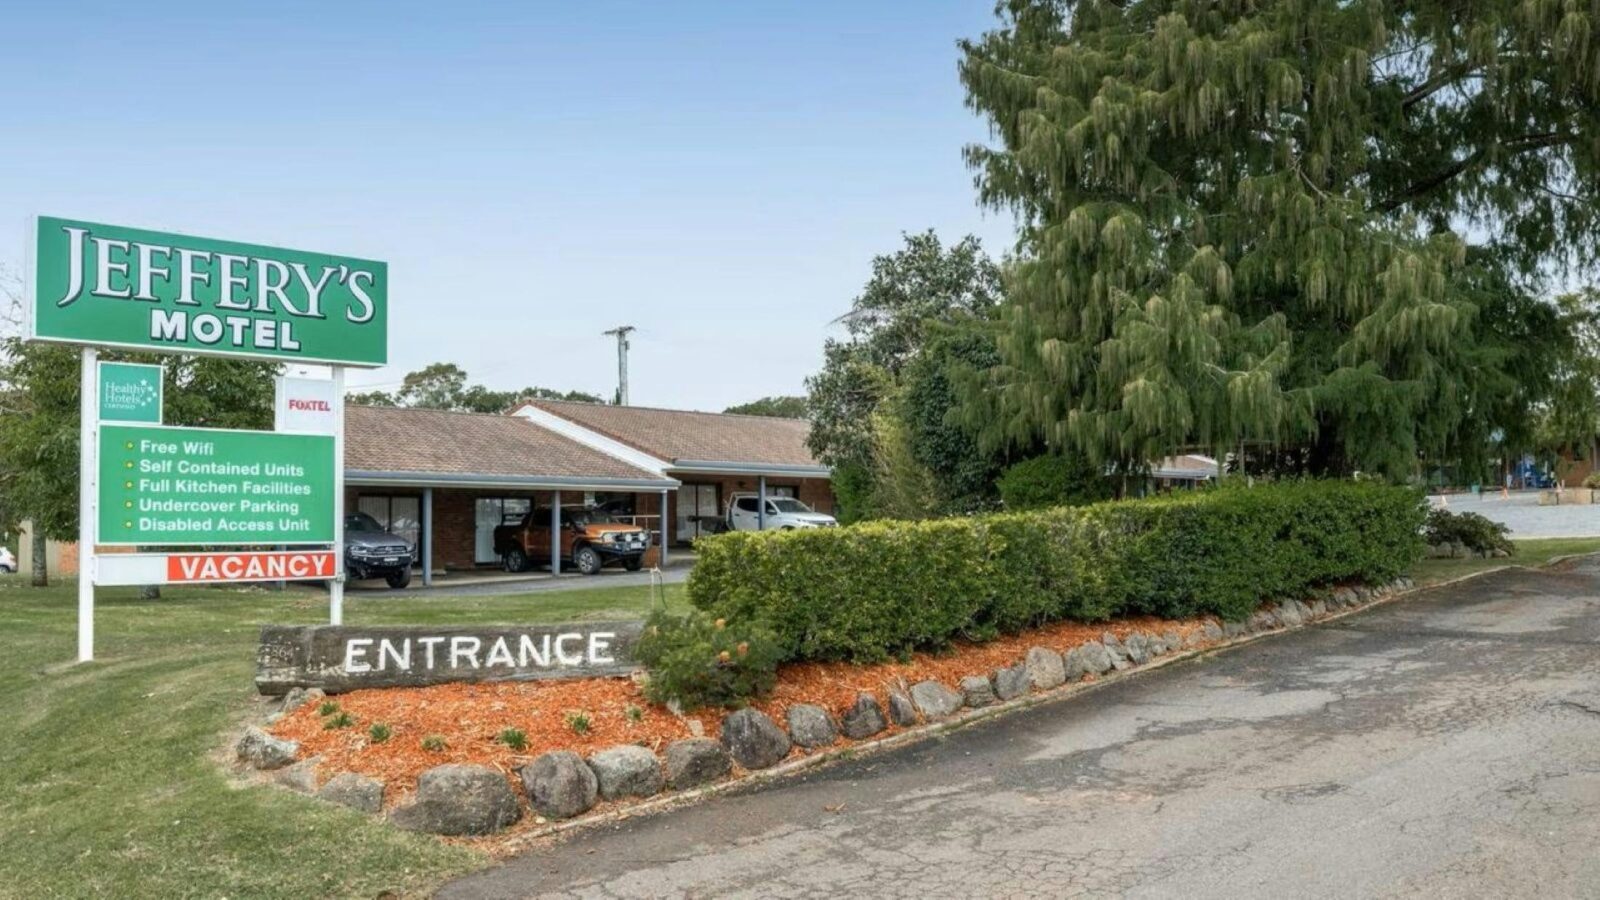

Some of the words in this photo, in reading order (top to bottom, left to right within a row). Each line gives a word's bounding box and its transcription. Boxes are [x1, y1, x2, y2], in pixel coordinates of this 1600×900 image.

[57, 226, 375, 323] JEFFERY'S
[150, 308, 301, 351] MOTEL
[105, 381, 145, 397] Healthy
[105, 391, 141, 405] Hotels
[288, 399, 331, 412] FOXTEL
[140, 439, 177, 454] Free
[183, 441, 214, 456] Wifi
[140, 460, 172, 473] Self
[178, 460, 260, 476] Contained
[264, 463, 304, 477] Units
[139, 479, 170, 493] Full
[175, 479, 237, 494] Kitchen
[243, 481, 311, 496] Facilities
[139, 498, 234, 513] Undercover
[240, 499, 299, 515] Parking
[139, 517, 212, 532] Disabled
[217, 517, 274, 532] Access
[278, 518, 310, 532] Unit
[179, 555, 328, 580] VACANCY
[344, 632, 616, 673] ENTRANCE
